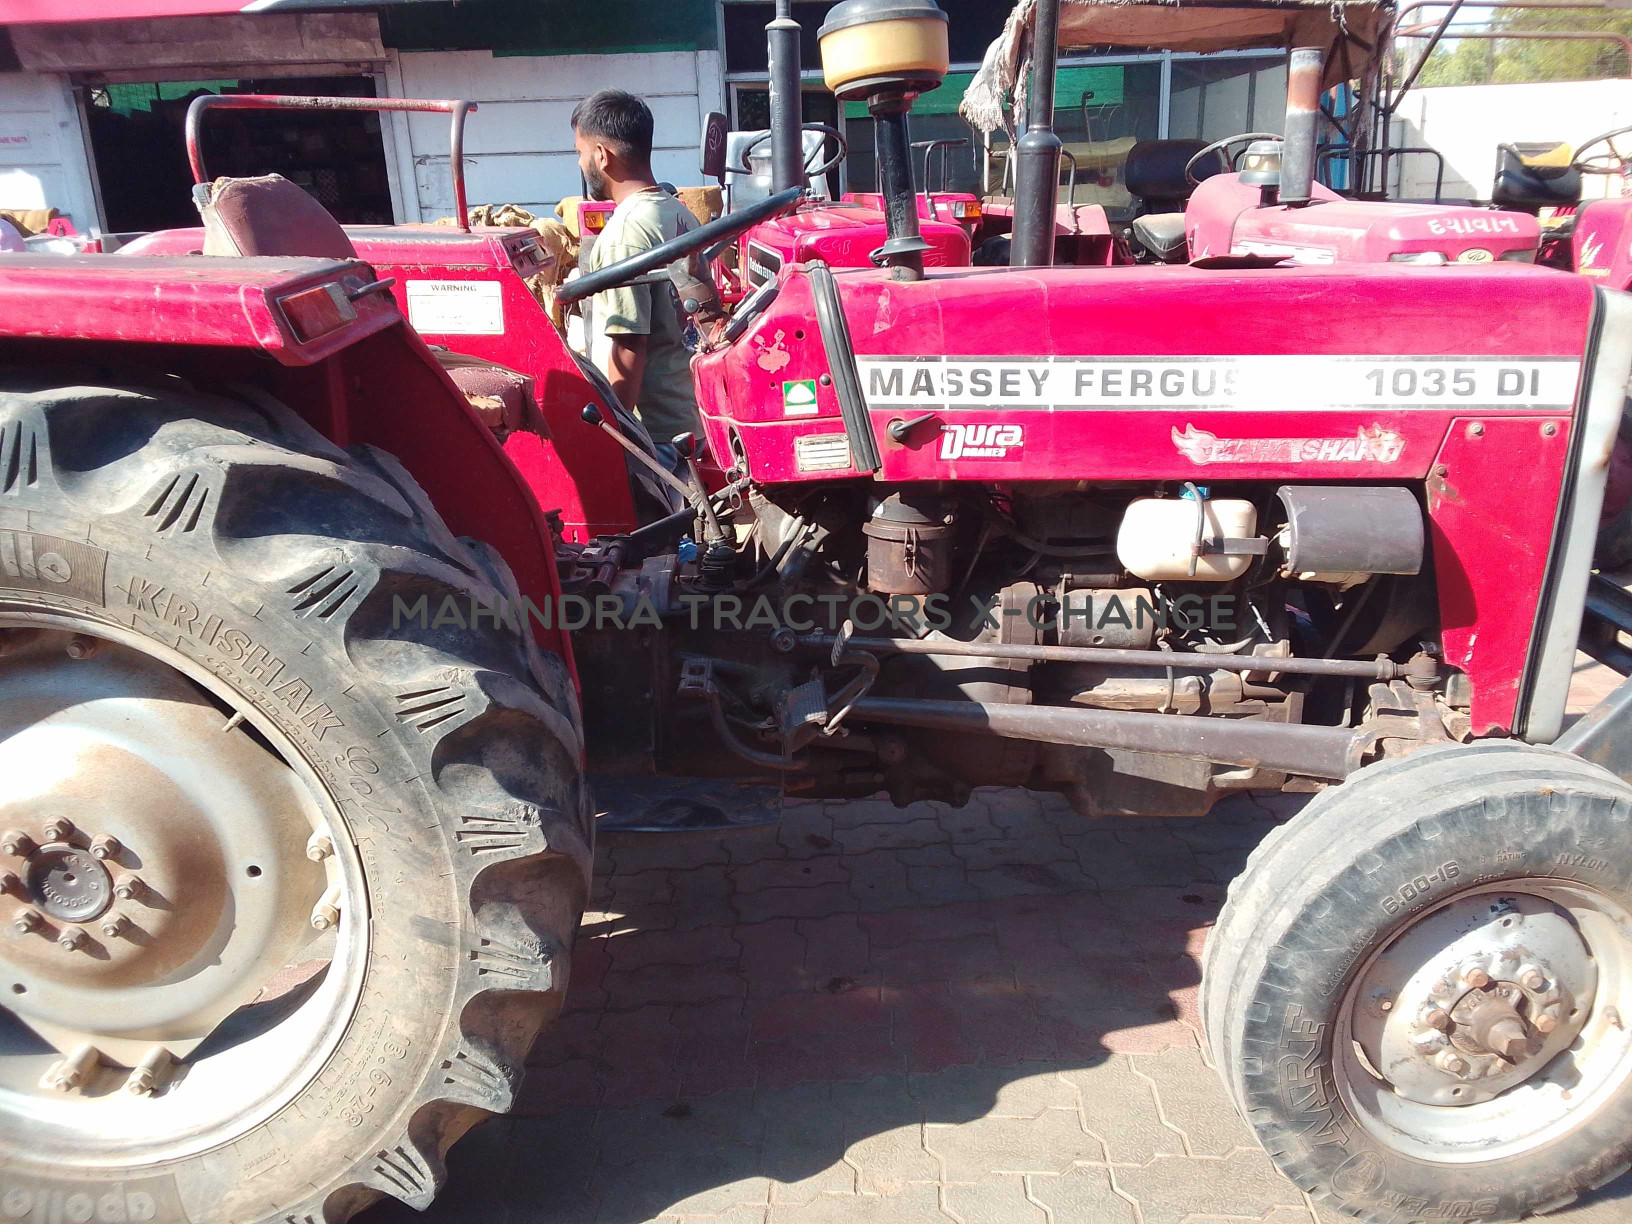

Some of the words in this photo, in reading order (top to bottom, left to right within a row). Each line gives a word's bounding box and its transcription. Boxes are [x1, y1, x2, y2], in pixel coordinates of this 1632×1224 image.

[431, 284, 477, 292] WARNING
[869, 367, 1051, 397] MASSEY
[1365, 368, 1476, 397] 1035
[1497, 368, 1540, 397] DI
[940, 424, 1024, 460] Dura
[127, 576, 345, 742] KRISHAK
[1497, 852, 1527, 863] RATING
[1556, 851, 1610, 873] NYLON
[1380, 860, 1461, 915] 6.00-16
[1278, 1003, 1350, 1153] MRF
[2, 1181, 157, 1224] apollo
[1376, 1189, 1501, 1219] SUPER
